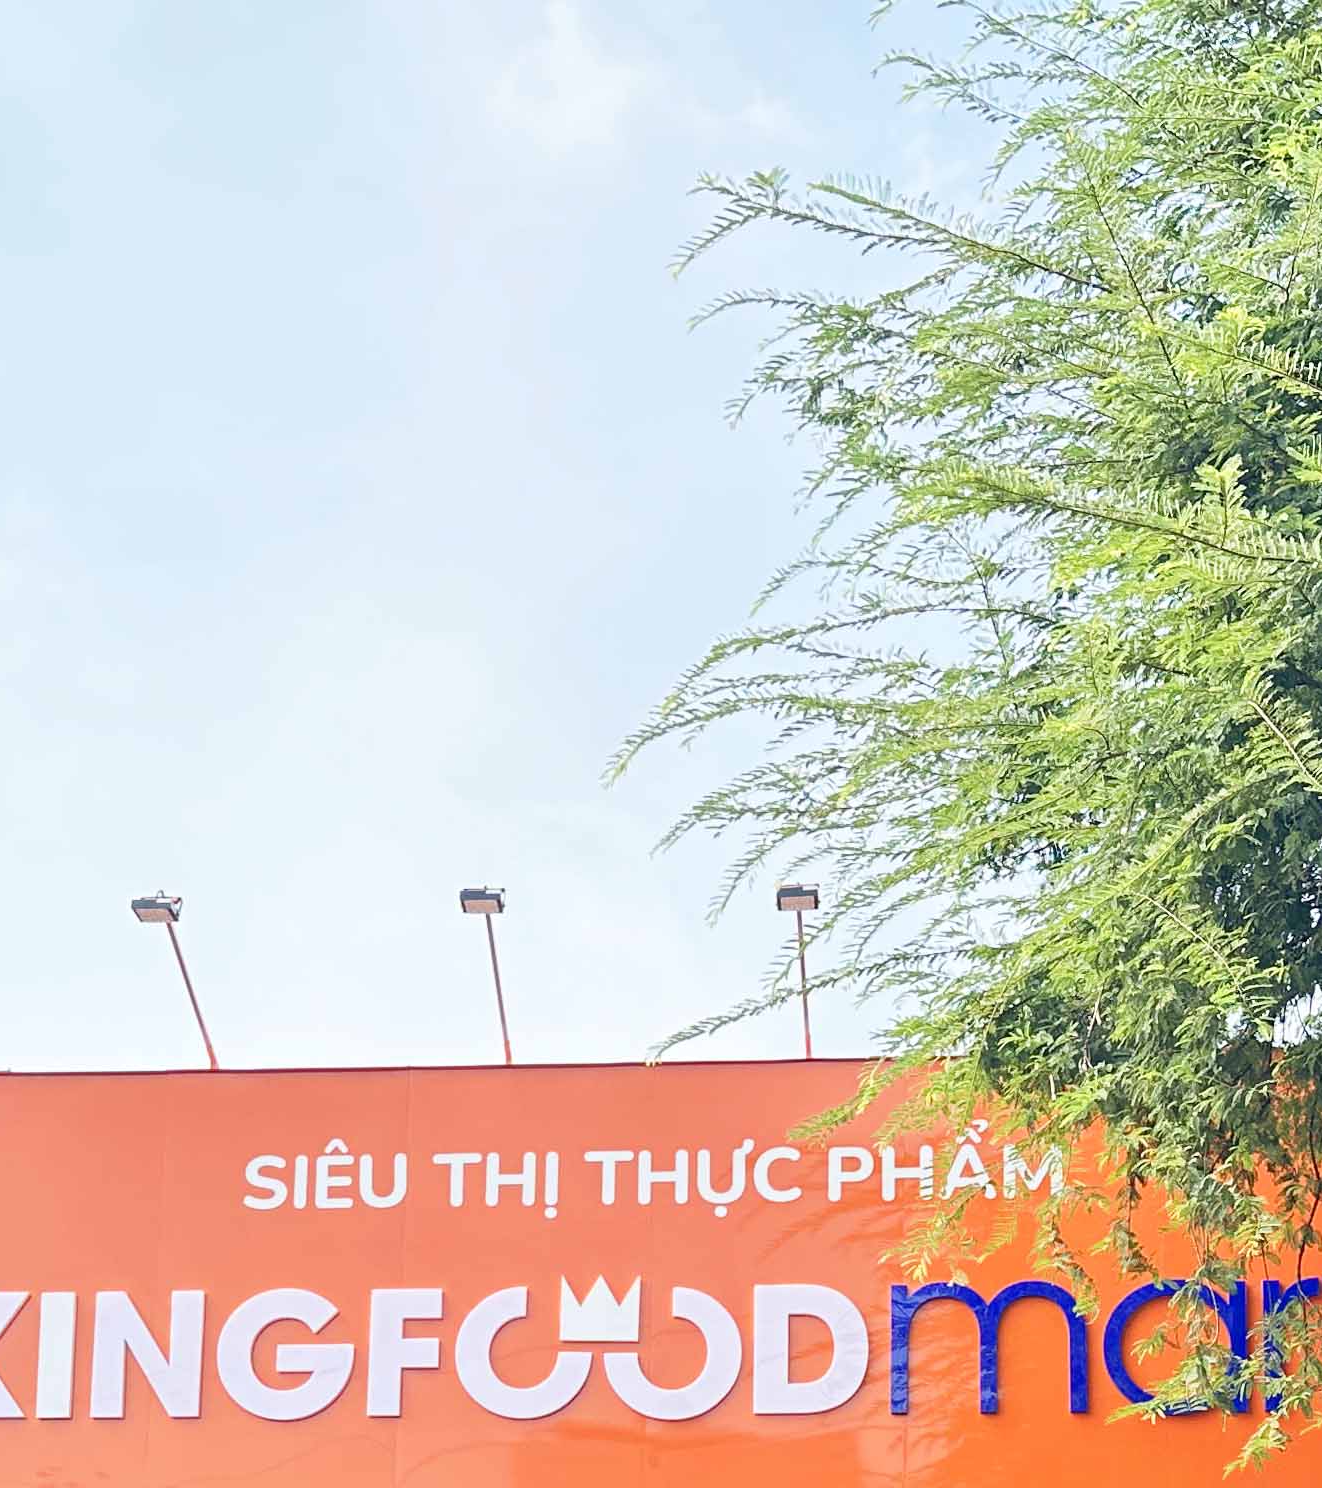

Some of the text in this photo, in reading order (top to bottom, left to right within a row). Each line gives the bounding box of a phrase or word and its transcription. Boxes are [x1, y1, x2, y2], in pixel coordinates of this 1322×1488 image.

[242, 1119, 1066, 1220] SIÊU THỊ THỰC PHẨM
